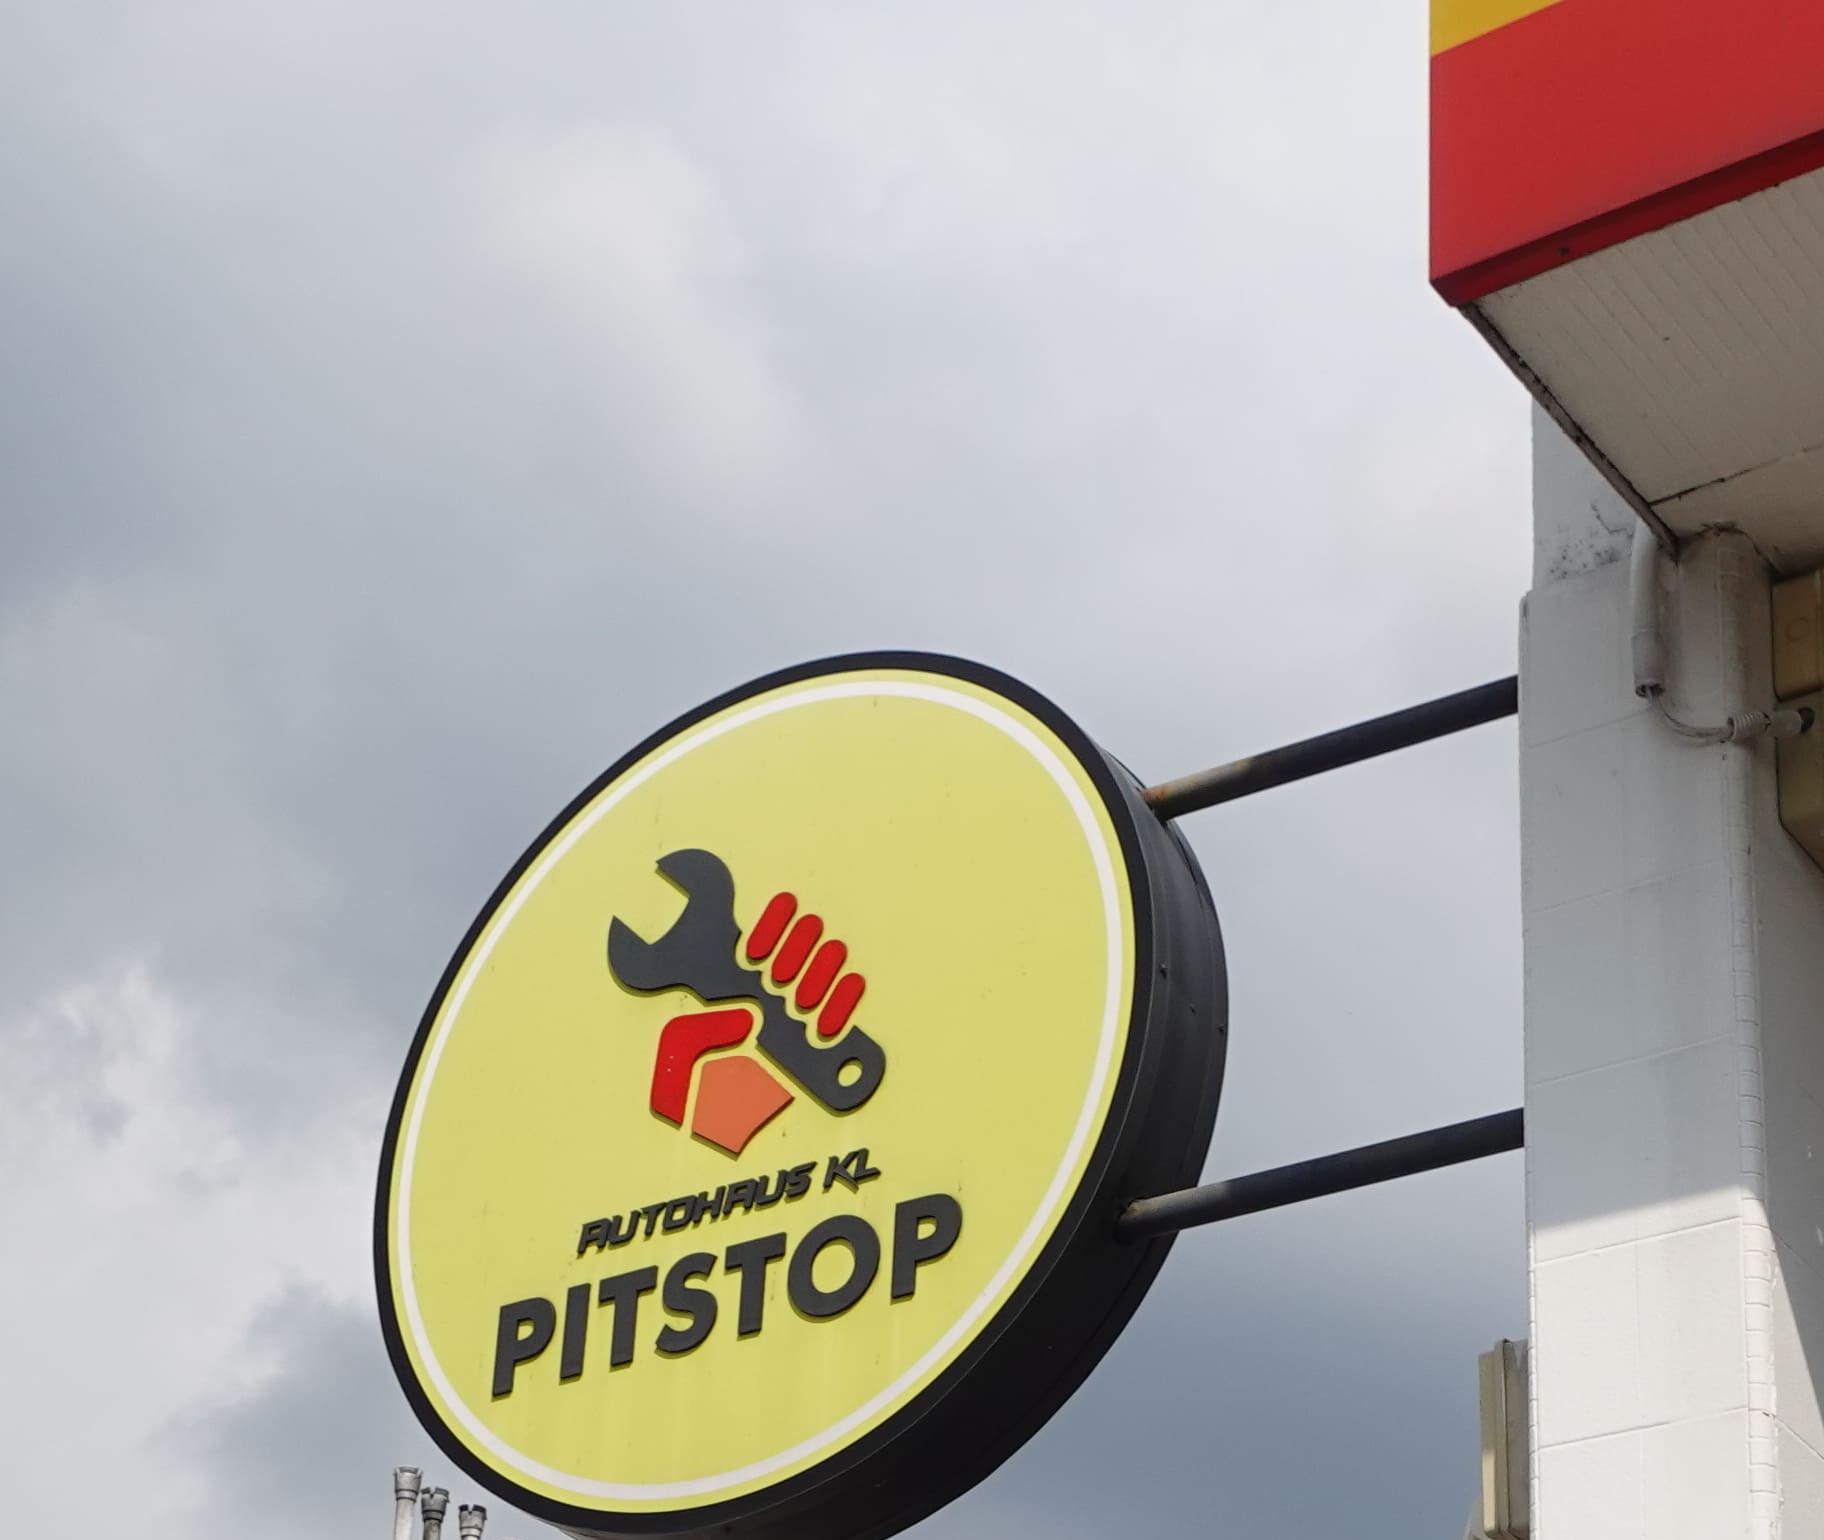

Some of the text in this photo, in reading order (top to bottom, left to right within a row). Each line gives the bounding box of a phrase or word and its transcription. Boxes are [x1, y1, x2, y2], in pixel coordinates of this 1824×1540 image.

[577, 1147, 881, 1258] AUTOHAUS KL
[491, 1193, 962, 1401] PITSTOP
